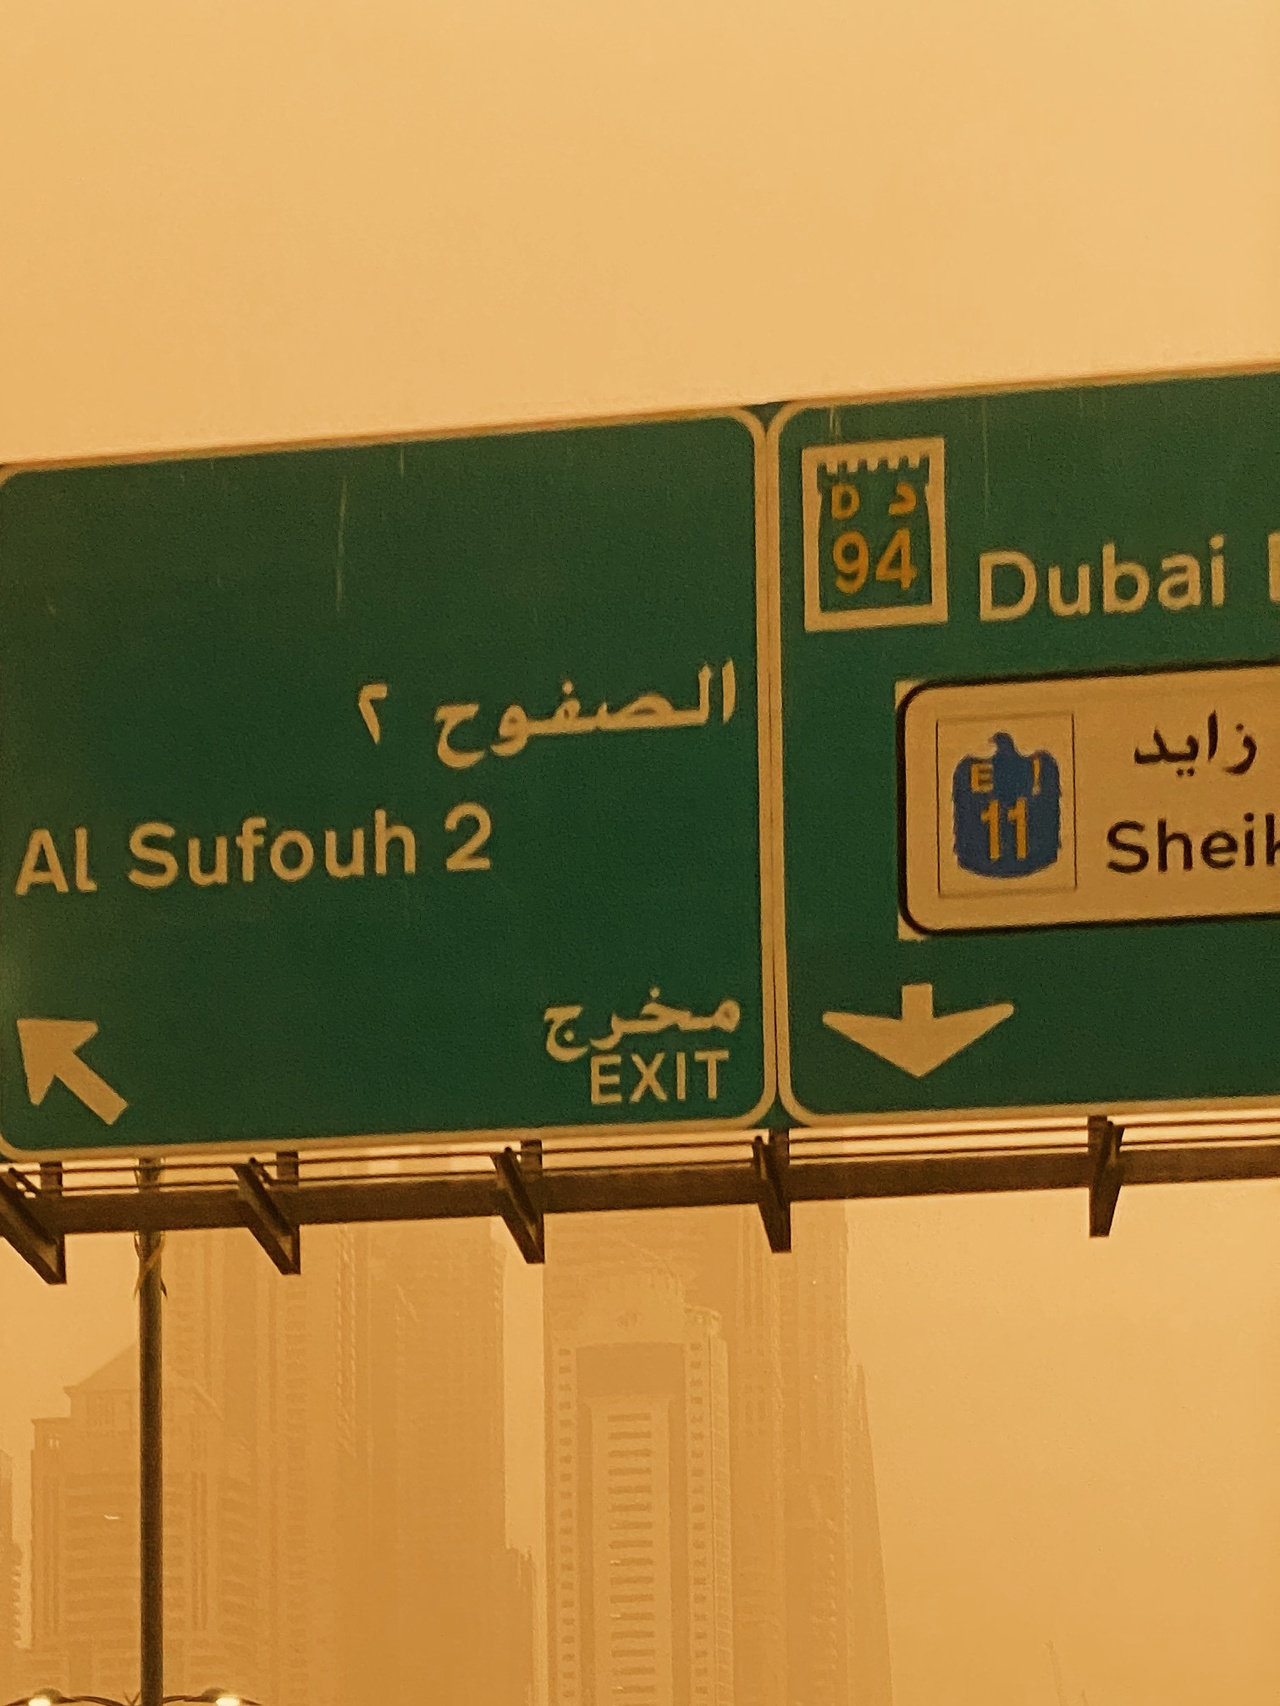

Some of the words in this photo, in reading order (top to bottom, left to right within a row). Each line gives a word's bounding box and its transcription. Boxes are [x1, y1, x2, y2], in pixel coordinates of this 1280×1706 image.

[831, 482, 860, 520] D
[888, 481, 917, 516] د
[832, 527, 918, 594] 94
[979, 532, 1226, 622] Dubai
[434, 658, 738, 769] الصفوح
[1133, 709, 1258, 778] زايد
[971, 762, 995, 795] E
[15, 827, 98, 896] Al
[128, 808, 417, 889] Sufouh
[444, 802, 493, 873] 2
[979, 798, 1028, 861] 11
[543, 986, 741, 1063] مخرج
[590, 1049, 730, 1105] EXIT
